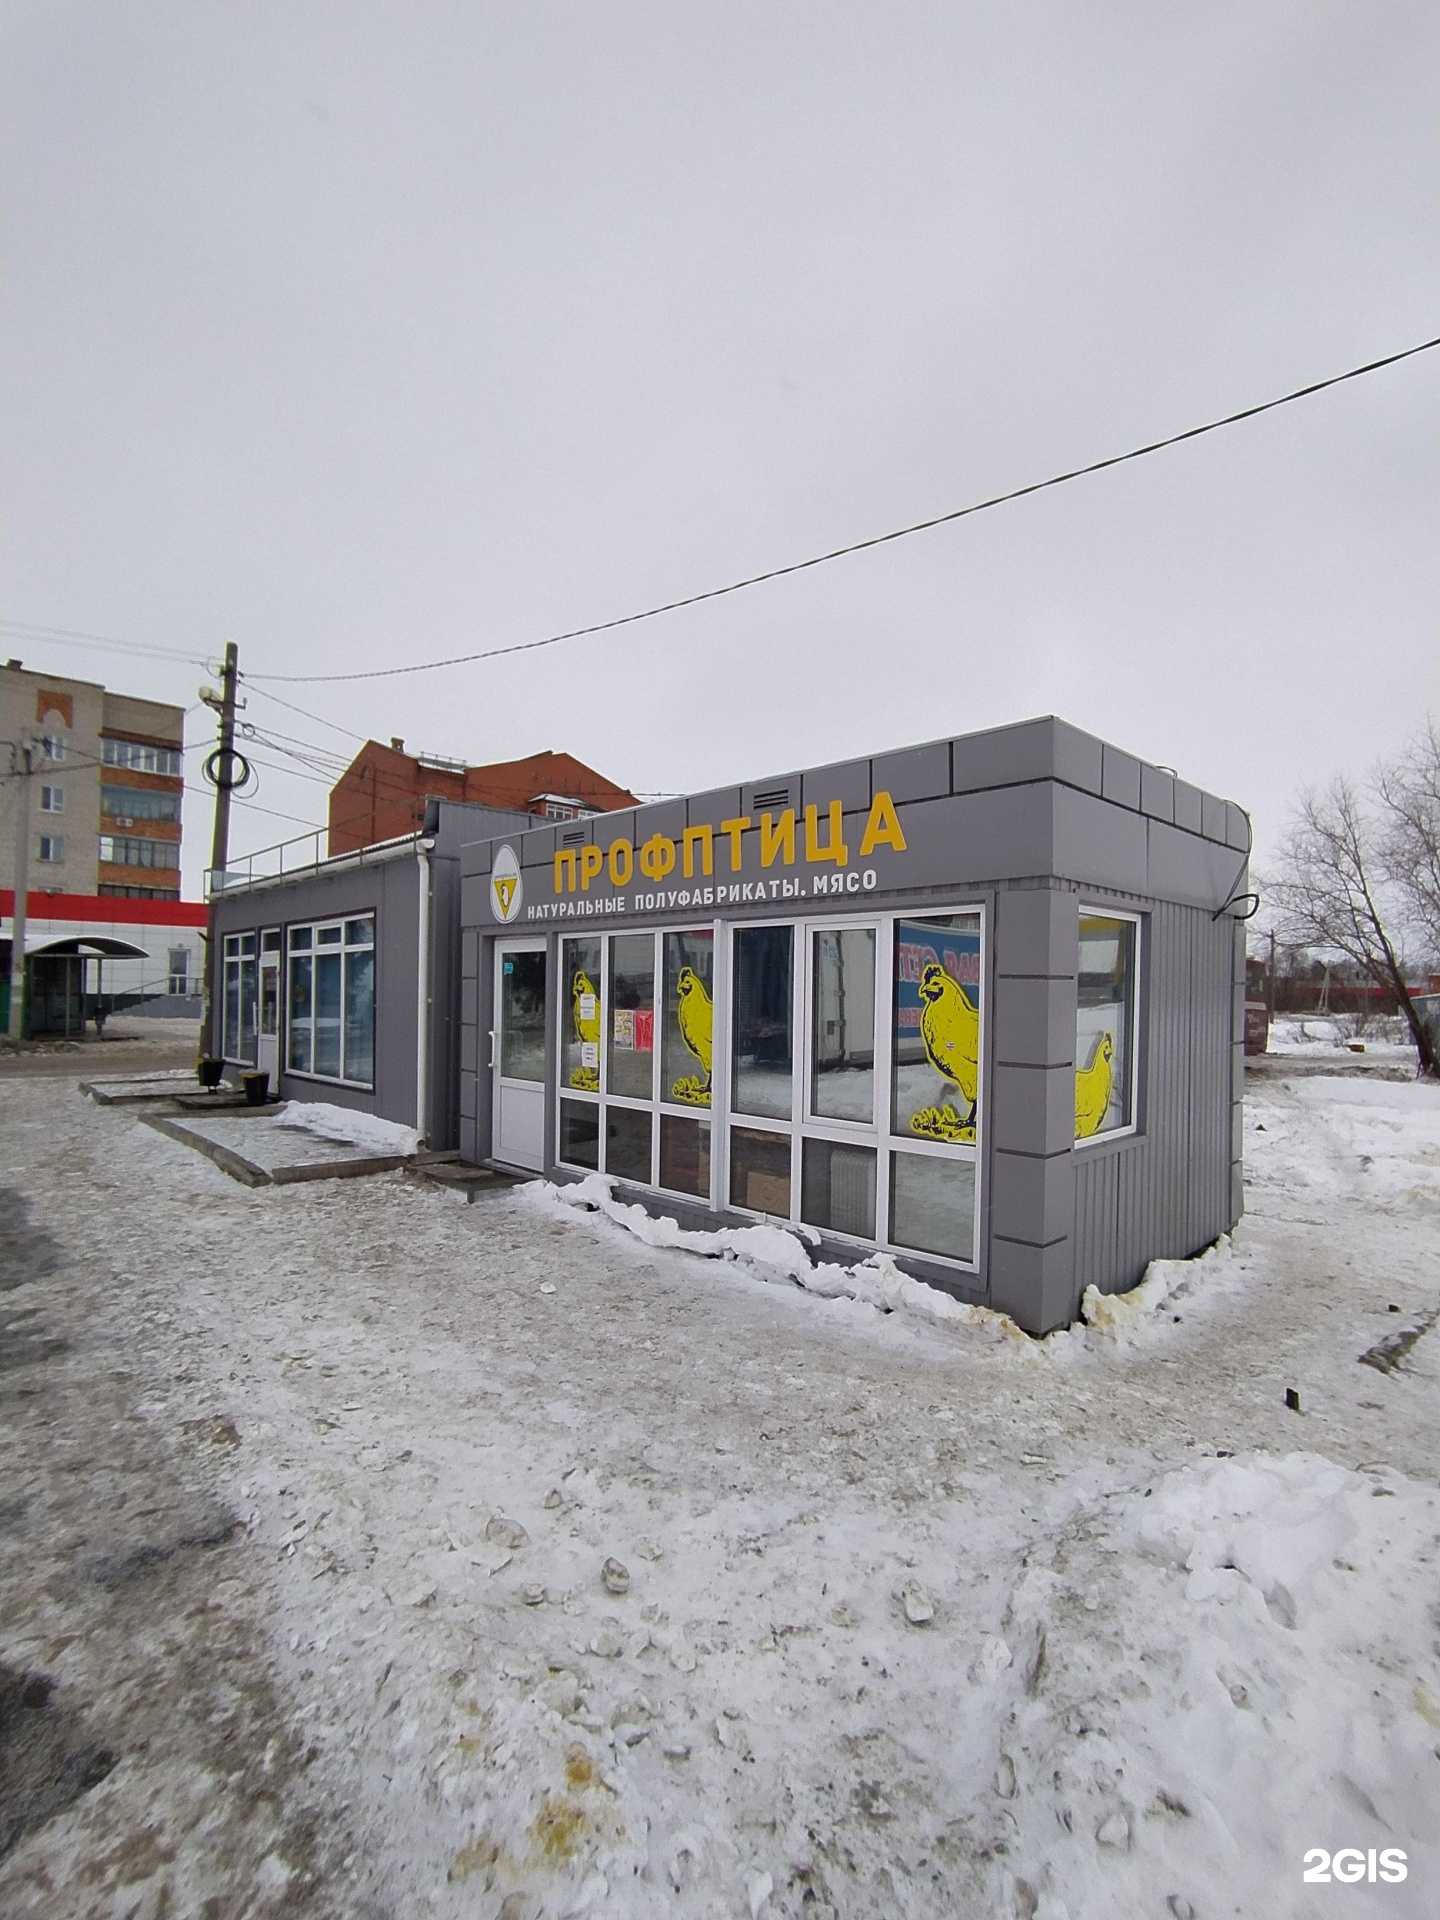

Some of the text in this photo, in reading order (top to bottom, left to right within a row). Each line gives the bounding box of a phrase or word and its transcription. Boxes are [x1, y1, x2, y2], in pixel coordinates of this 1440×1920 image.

[553, 791, 907, 895] ПРОФПТИЦА
[527, 869, 878, 920] НАТУРАЛЬНЫЕ ПОЛУФАБРИКАТЫ. МЯСО
